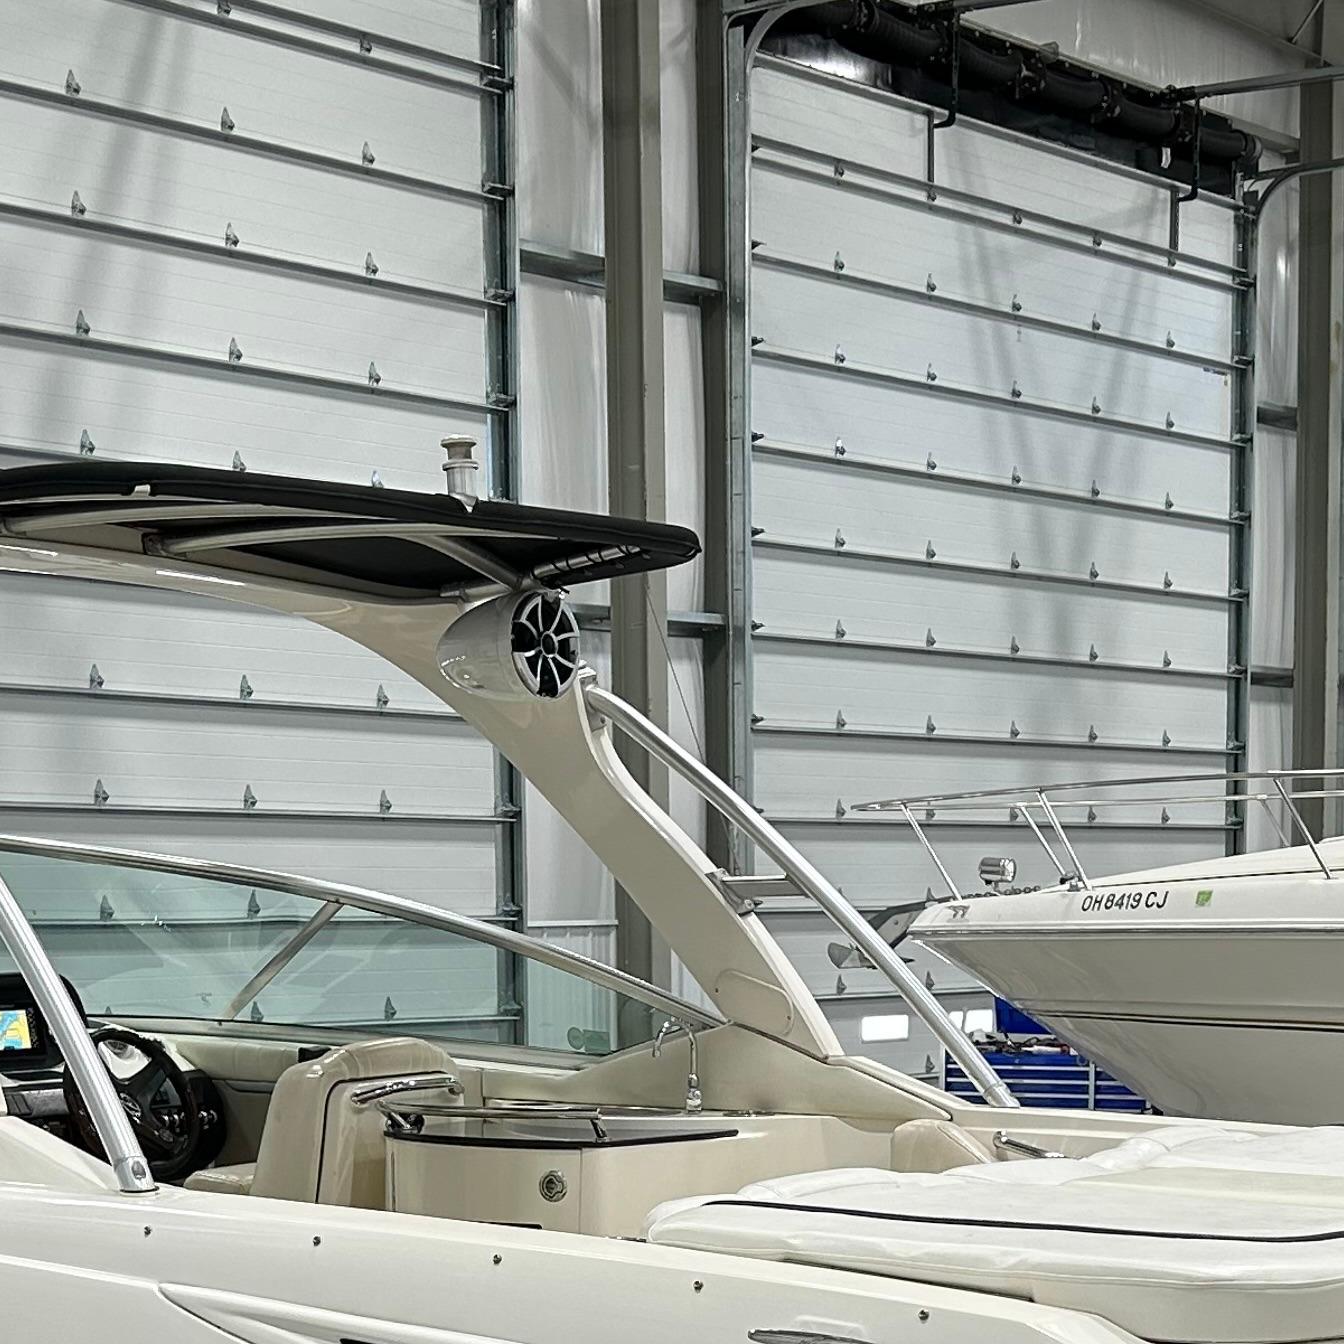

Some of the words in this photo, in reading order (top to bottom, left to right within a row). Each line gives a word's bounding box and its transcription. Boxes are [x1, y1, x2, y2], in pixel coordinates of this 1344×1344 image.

[1081, 895, 1105, 912] OH
[1105, 893, 1142, 911] 8419
[1144, 891, 1170, 909] CJ
